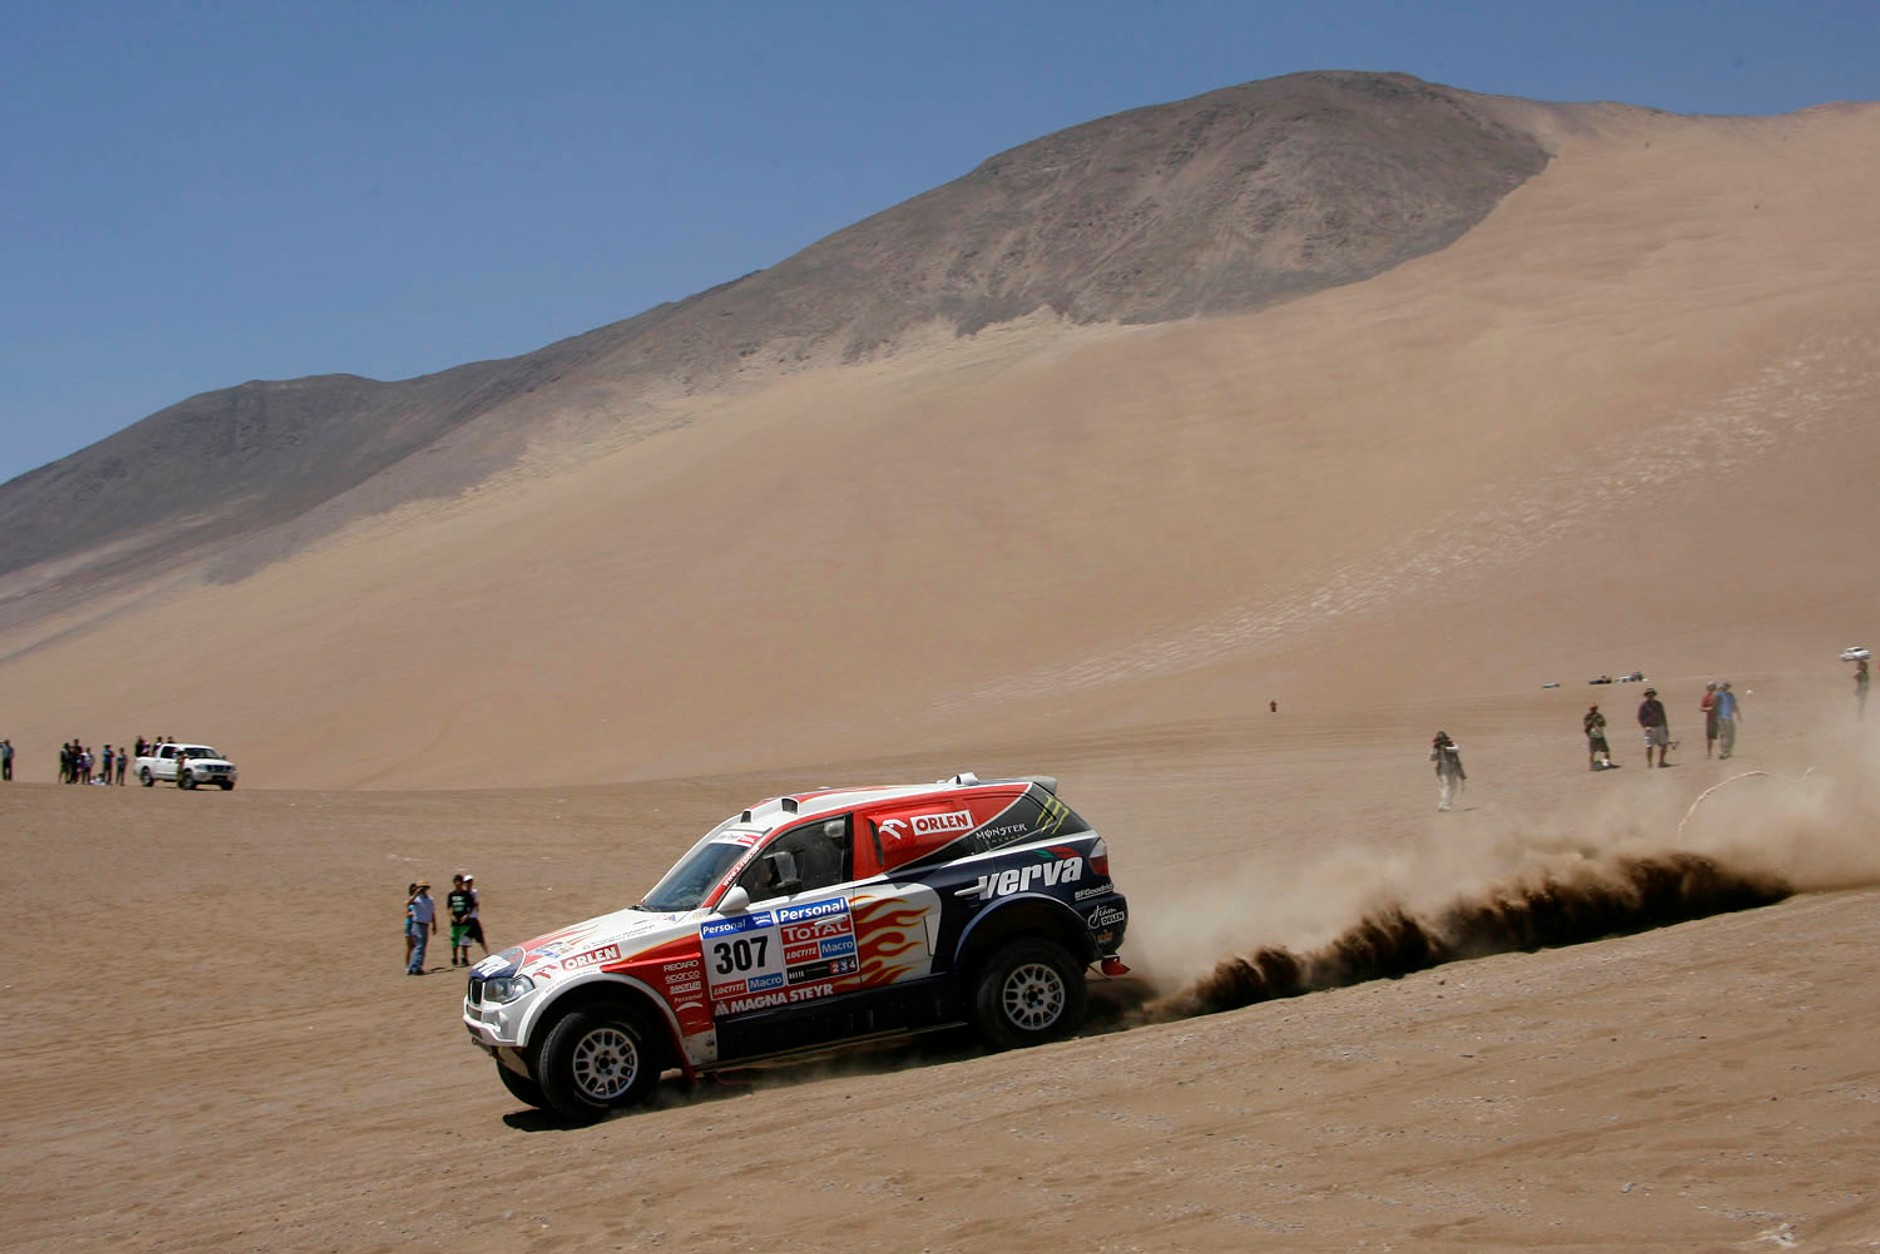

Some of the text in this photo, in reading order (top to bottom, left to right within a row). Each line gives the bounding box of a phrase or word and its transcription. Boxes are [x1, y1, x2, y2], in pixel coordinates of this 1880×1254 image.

[915, 812, 969, 832] ORLEN
[978, 856, 1083, 900] verva
[779, 898, 845, 922] Personal
[702, 918, 746, 935] Personal
[782, 922, 850, 942] TOTAL
[713, 935, 769, 975] 307
[821, 939, 854, 954] Macro
[563, 946, 618, 971] ORLEN
[663, 959, 699, 972] RECARO
[749, 975, 782, 990] Macro
[730, 984, 834, 1013] MAGNA STEYR
